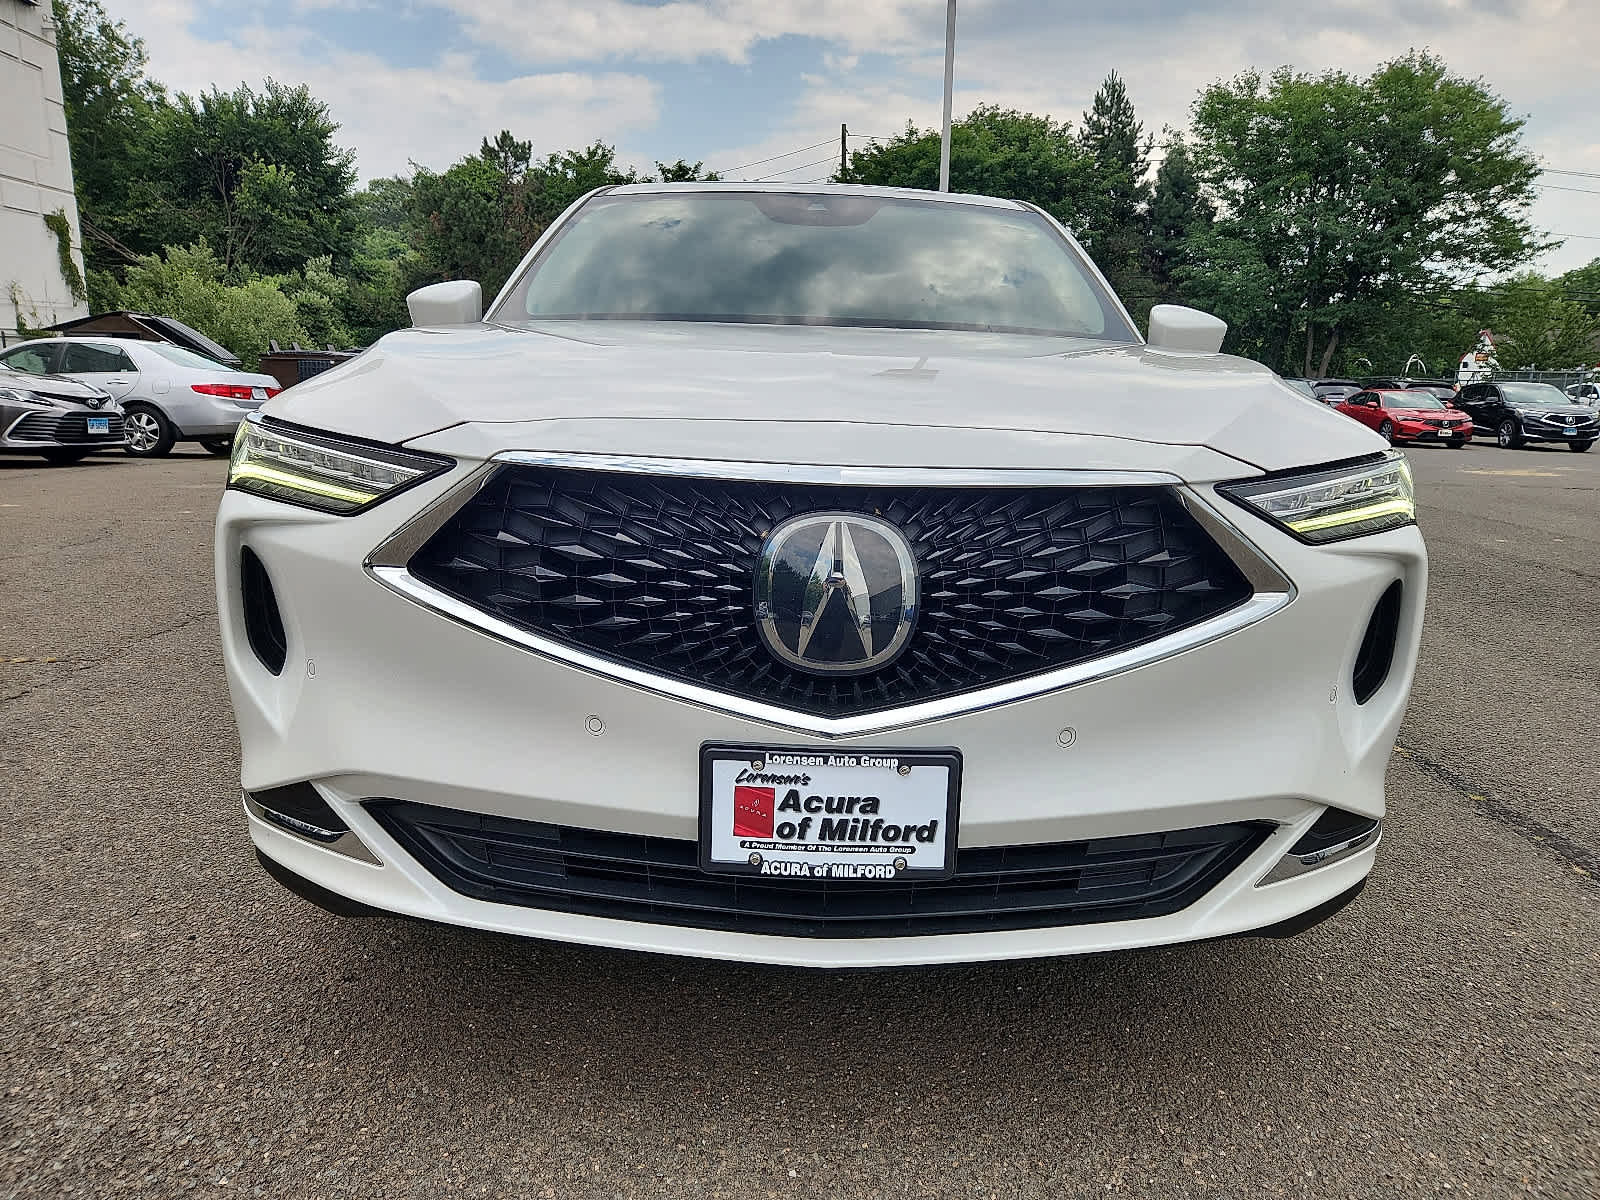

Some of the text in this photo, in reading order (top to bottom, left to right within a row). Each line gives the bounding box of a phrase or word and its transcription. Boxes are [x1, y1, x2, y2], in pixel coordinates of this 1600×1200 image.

[765, 753, 899, 770] Lorensen Auto Group
[735, 768, 812, 786] Lorensen's
[739, 804, 768, 818] ACURA
[777, 789, 880, 815] Acura
[776, 816, 938, 843] of Milford
[751, 842, 774, 850] Proud
[760, 861, 896, 879] ACURA of MILFORD
